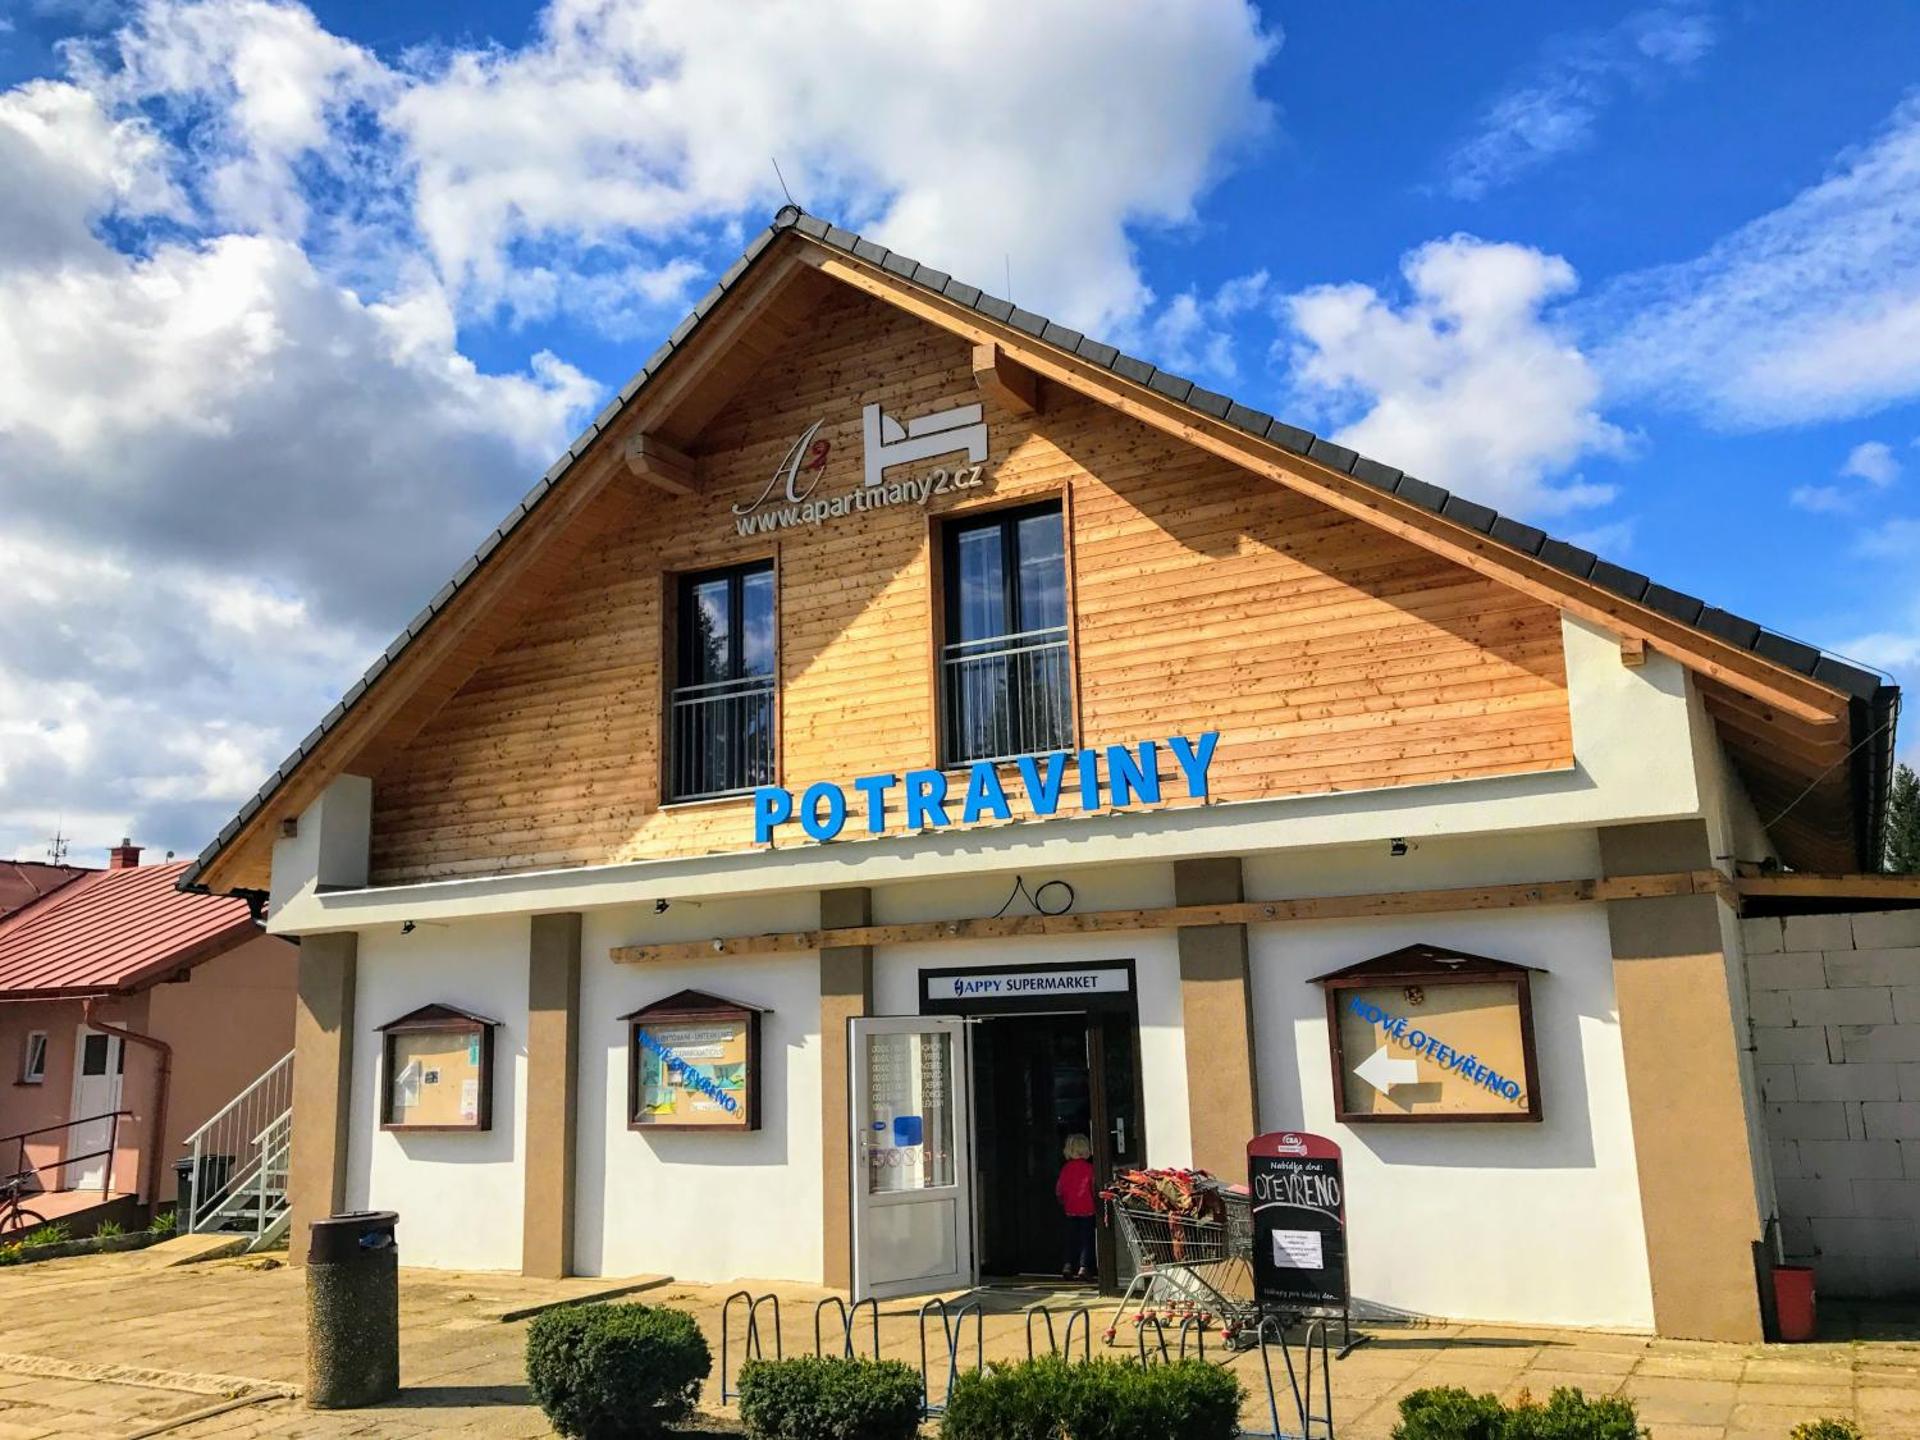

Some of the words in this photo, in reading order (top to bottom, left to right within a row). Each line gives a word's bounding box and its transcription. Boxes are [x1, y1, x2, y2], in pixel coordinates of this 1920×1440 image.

[735, 464, 984, 537] www.apartmany2.cz
[754, 731, 1220, 843] POTRAVINY
[1006, 975, 1098, 992] SUPERMARKET
[1349, 996, 1409, 1038] NOVĚ
[1409, 1029, 1520, 1100] OTEVŘENO
